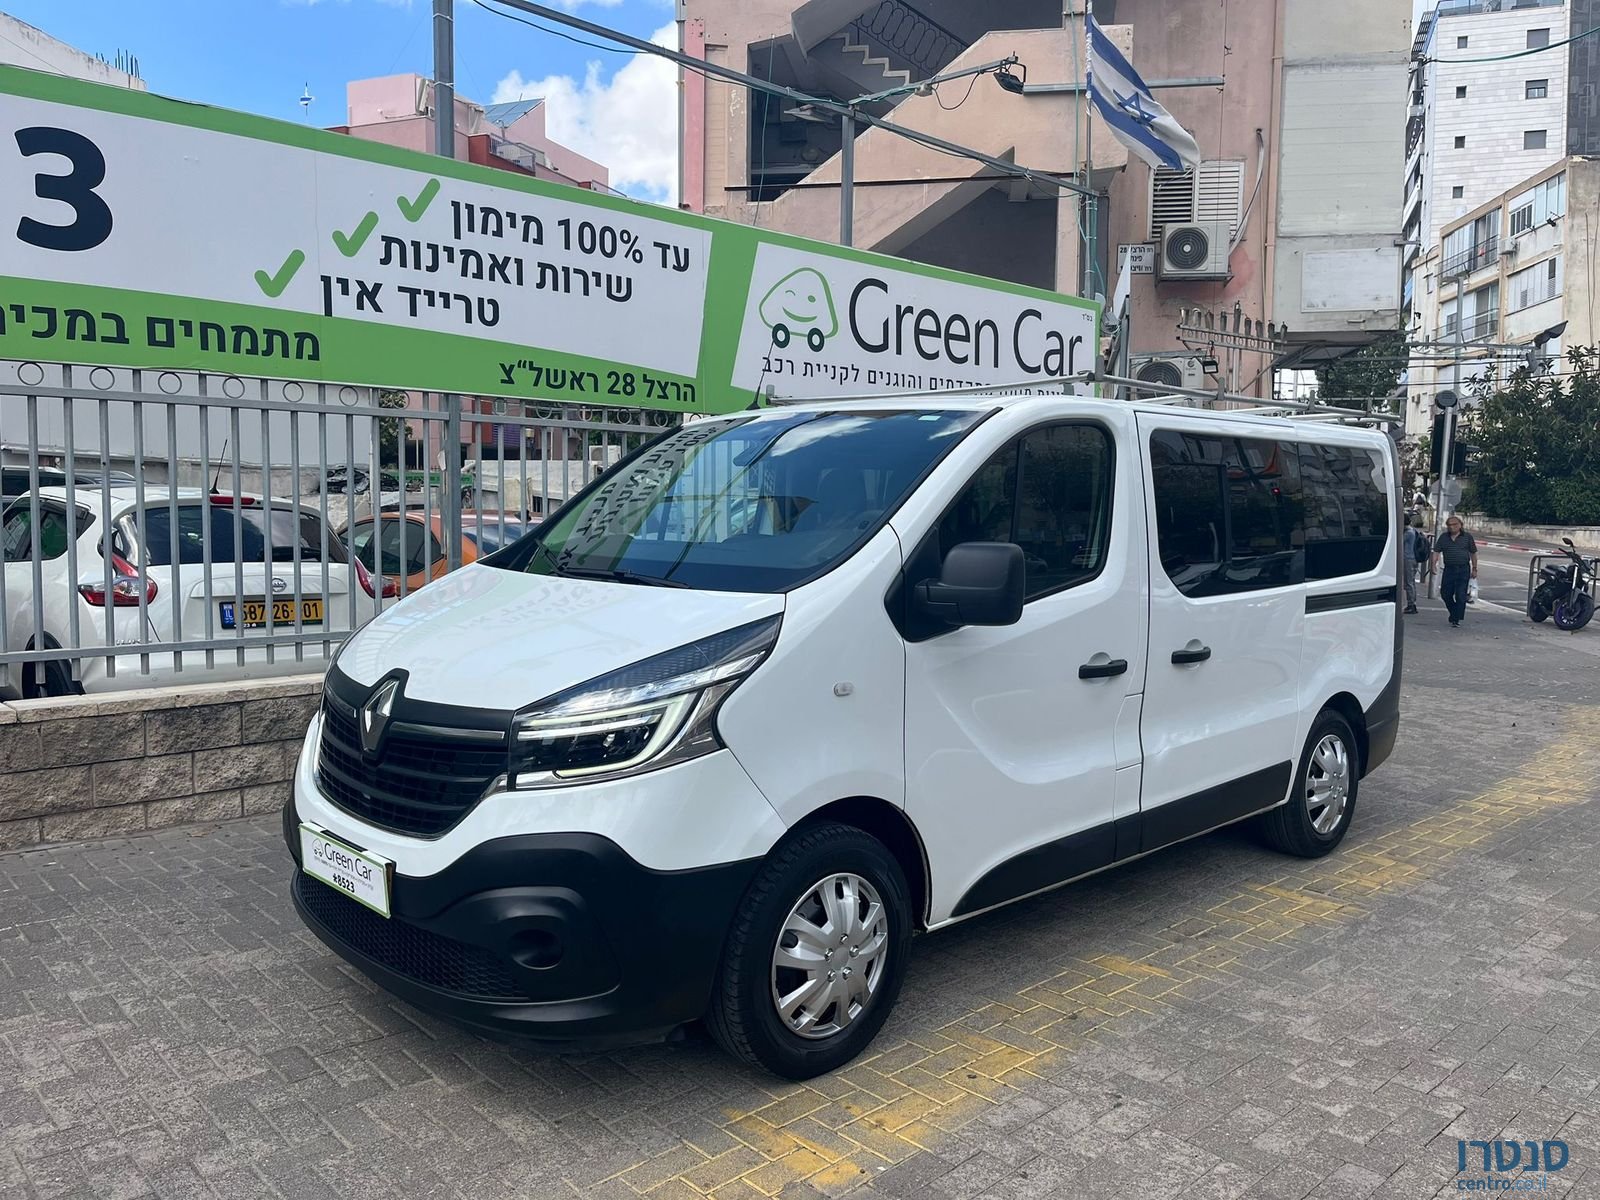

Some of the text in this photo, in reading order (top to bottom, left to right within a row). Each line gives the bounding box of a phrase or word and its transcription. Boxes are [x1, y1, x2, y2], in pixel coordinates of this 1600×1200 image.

[15, 127, 112, 250] 3
[450, 200, 690, 273] עד 100% מימון
[379, 234, 633, 304] שירות ואמינות
[320, 274, 500, 327] טרייד אין
[0, 302, 320, 362] מתמחים במכי
[849, 278, 1083, 378] Green Car
[606, 370, 636, 397] 28
[642, 373, 696, 403] הרצל
[761, 356, 795, 376] רכב
[802, 361, 861, 385] לקניית
[867, 369, 923, 391] והוגנים
[324, 842, 354, 872] Green
[354, 858, 372, 881] Car
